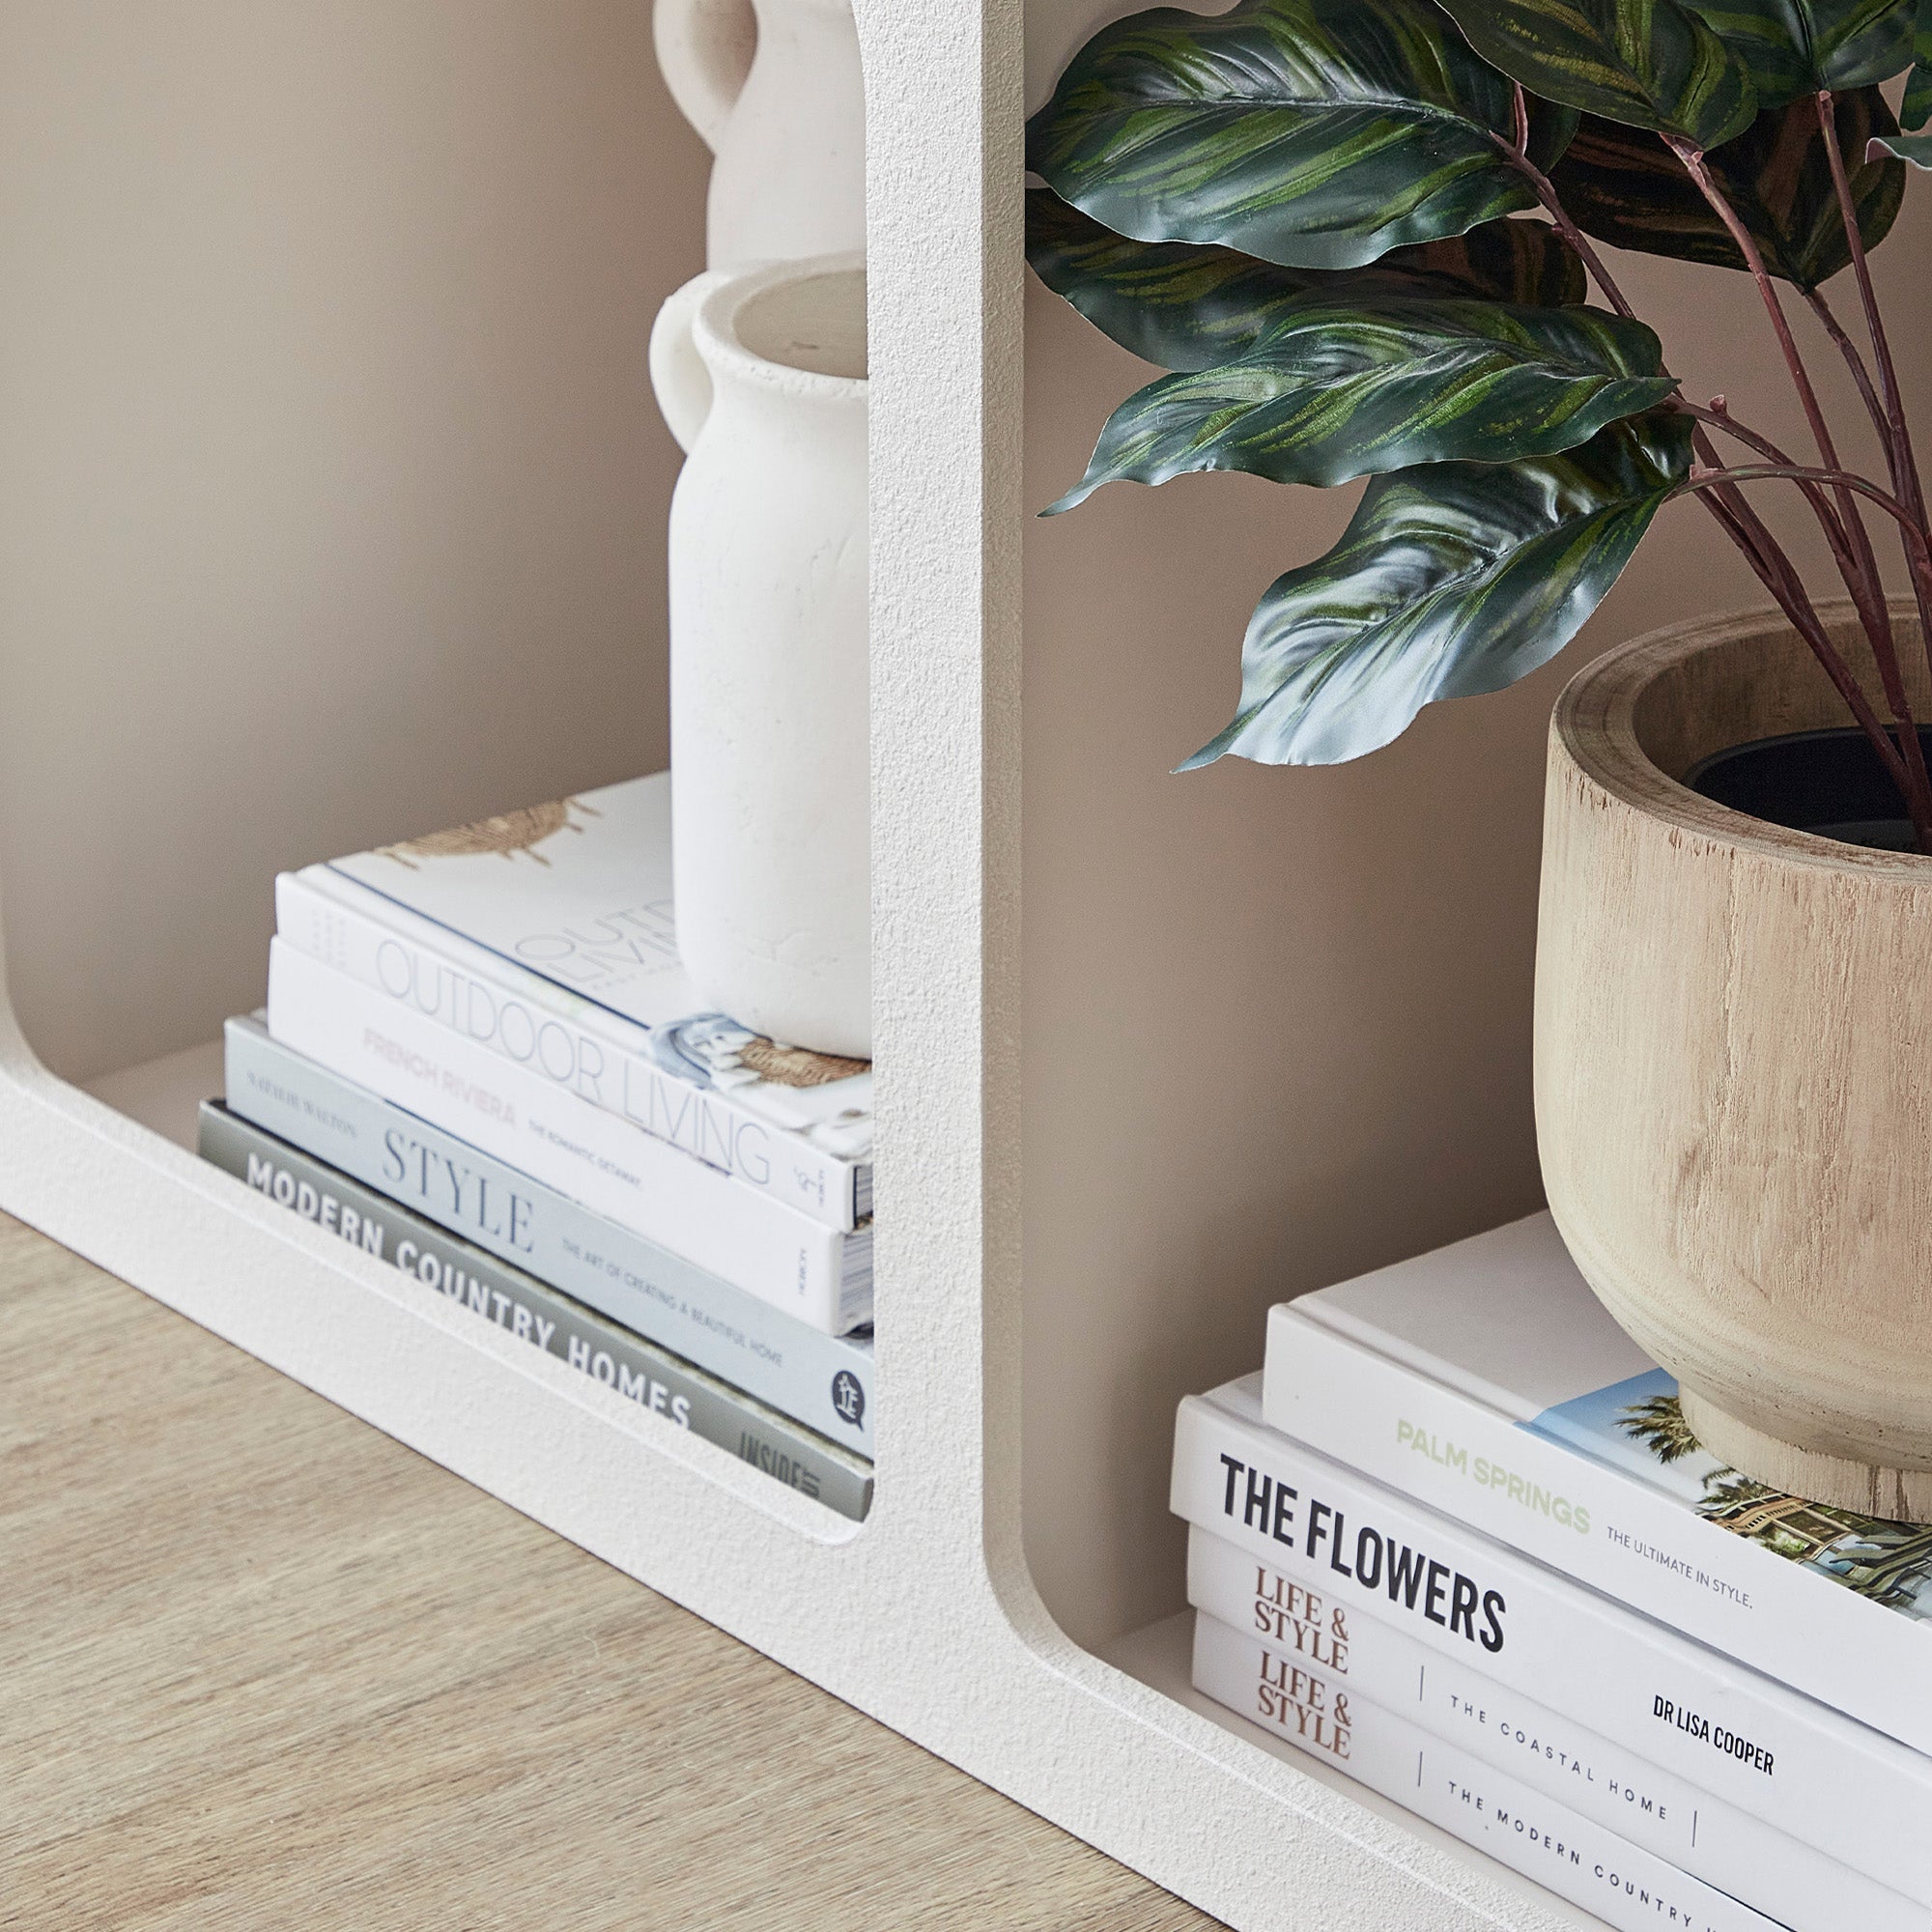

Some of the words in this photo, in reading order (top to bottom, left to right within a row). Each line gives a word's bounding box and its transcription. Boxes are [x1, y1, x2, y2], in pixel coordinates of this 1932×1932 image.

[363, 1027, 438, 1083] FRENCH
[441, 1070, 517, 1129] RIVIERA
[376, 938, 605, 1104] OUTDOOR
[623, 1056, 771, 1185] LIVING
[382, 1128, 533, 1254] STYLE
[246, 1152, 384, 1259] MODERN
[396, 1239, 556, 1351] COUNTRY
[568, 1335, 692, 1431] HOMES
[1397, 1418, 1467, 1476] PALM
[1472, 1456, 1591, 1535] SPRINGS
[1220, 1453, 1298, 1548] THE
[1306, 1498, 1506, 1653] FLOWERS
[1256, 1566, 1323, 1628] LIFE
[1332, 1607, 1350, 1641] &
[1607, 1525, 1631, 1548] THE
[1634, 1540, 1693, 1579] ULTIMATE
[1696, 1570, 1710, 1587] IN
[1713, 1578, 1754, 1609] STYLE.
[1255, 1600, 1350, 1675] STYLE
[1260, 1650, 1326, 1713] LIFE
[1334, 1692, 1352, 1726] &
[1258, 1684, 1351, 1760] STYLE
[1451, 1694, 1487, 1723] THE
[1500, 1721, 1595, 1781] COASTAL
[1609, 1779, 1667, 1820] HOME
[1653, 1694, 1674, 1723] DR
[1677, 1706, 1710, 1744] LISA
[1713, 1726, 1775, 1776] COOPER
[1448, 1781, 1484, 1811] THE
[1496, 1808, 1580, 1865] MODERN
[1594, 1864, 1692, 1928] COUNTRY
